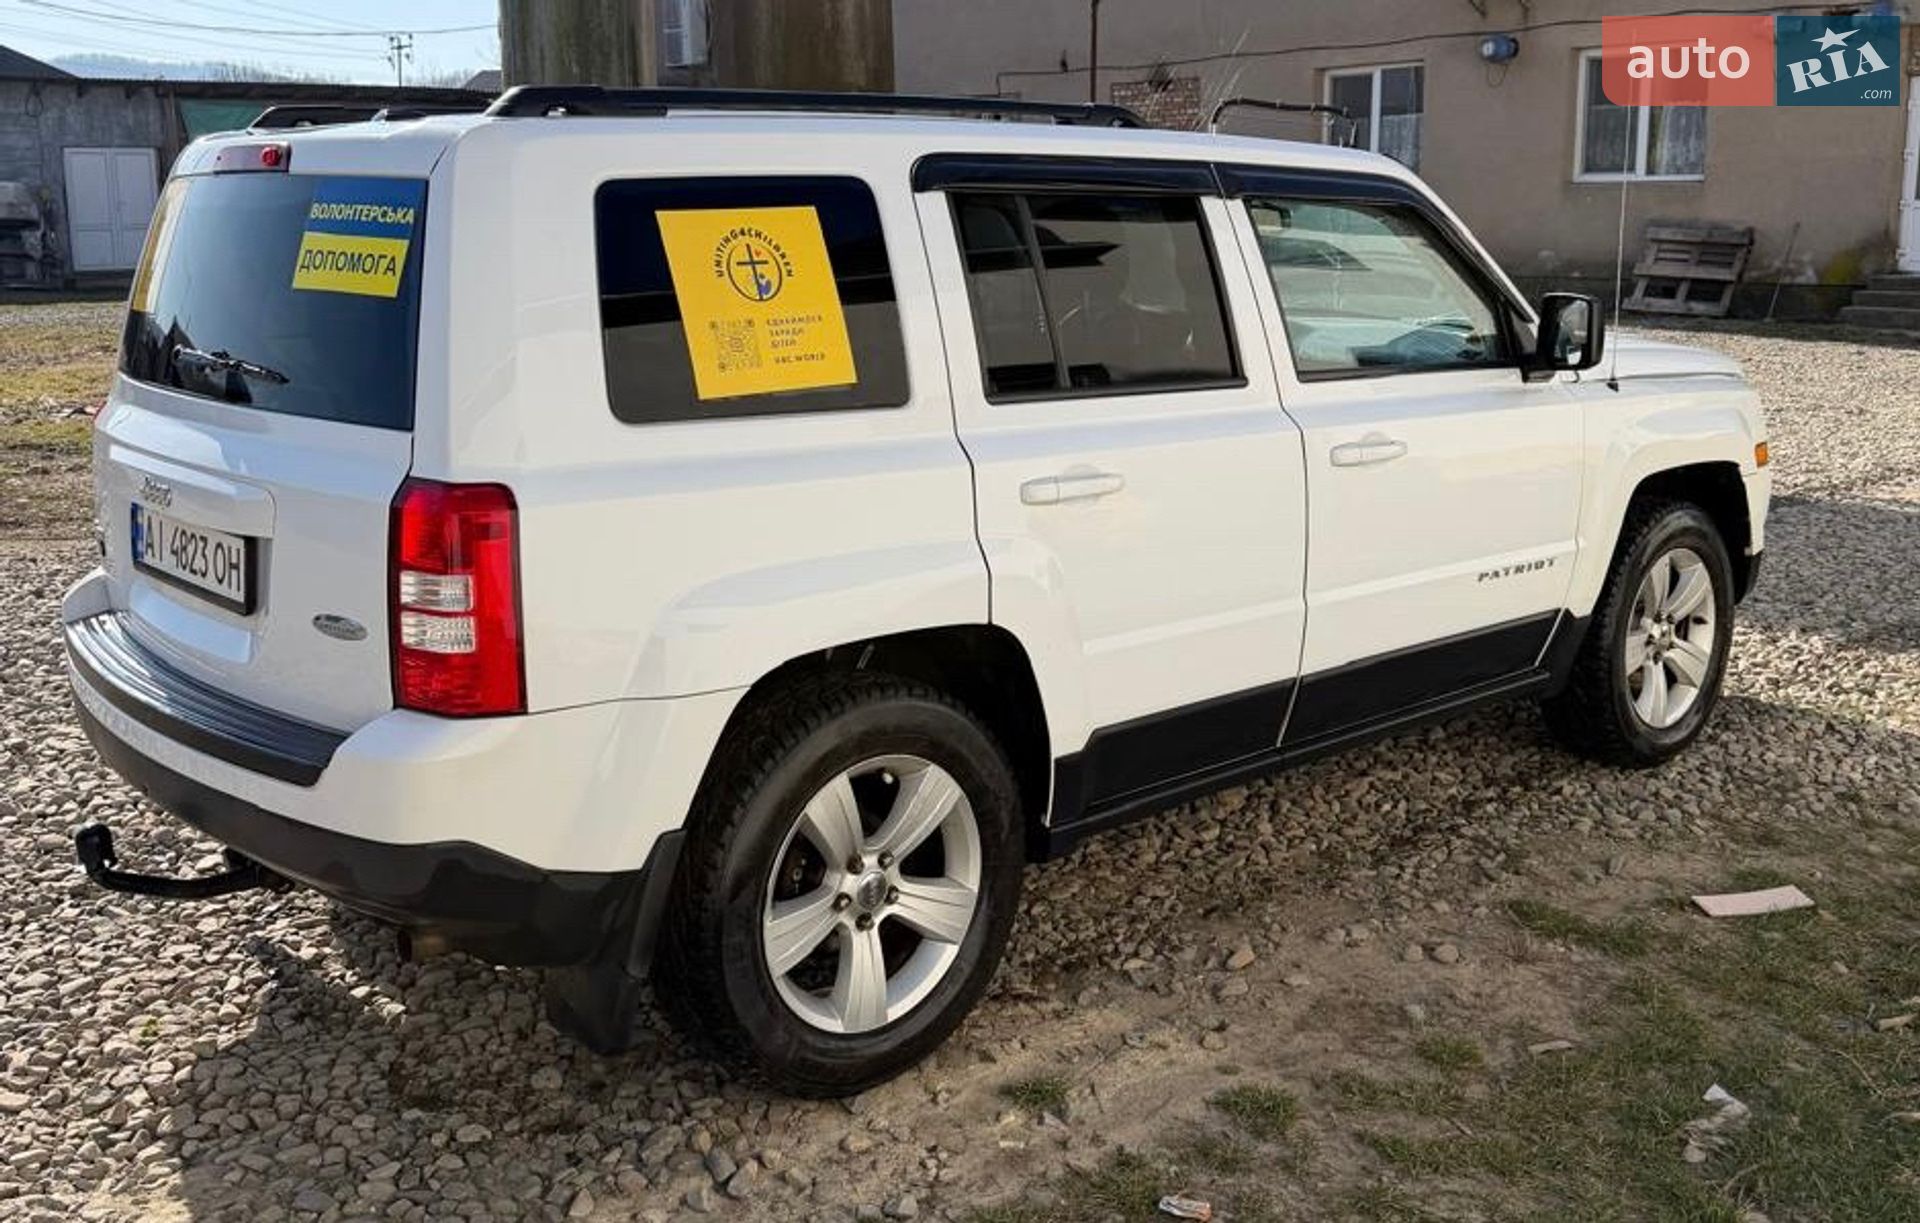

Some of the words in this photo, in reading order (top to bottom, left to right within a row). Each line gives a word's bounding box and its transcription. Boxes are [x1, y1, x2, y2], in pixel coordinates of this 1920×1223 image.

[310, 202, 415, 225] ВОЛОНТЕРСЬКА
[299, 248, 397, 277] ДОПОМОГА
[170, 528, 209, 578] 4823
[213, 545, 243, 593] OH
[1477, 556, 1557, 583] PATRIOT
